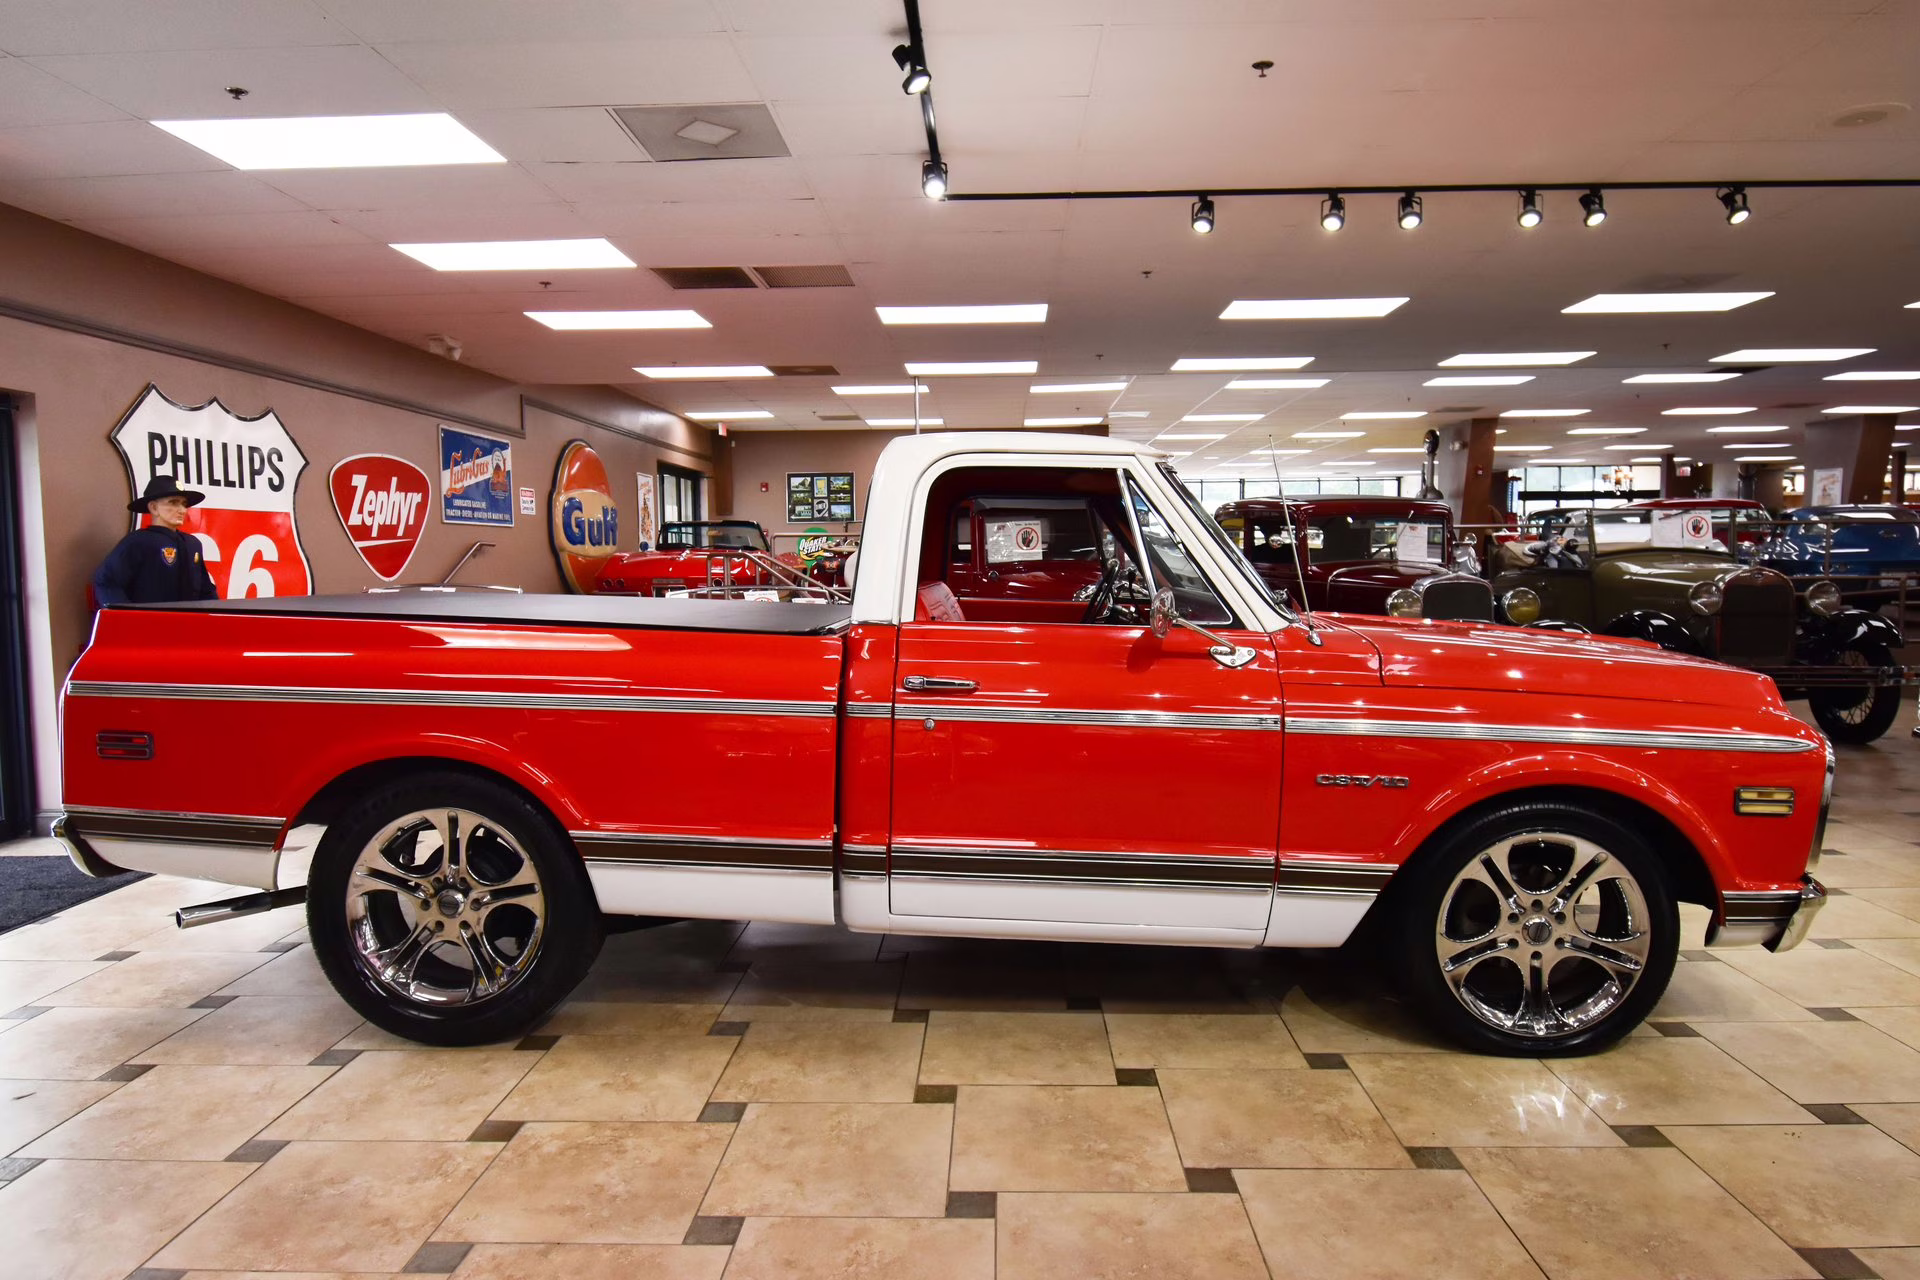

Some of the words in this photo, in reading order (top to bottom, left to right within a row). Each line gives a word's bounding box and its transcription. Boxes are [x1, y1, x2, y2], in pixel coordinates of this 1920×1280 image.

[148, 432, 284, 492] PHILLIPS
[347, 474, 422, 538] Zephyr
[562, 497, 618, 547] Gulf
[1316, 774, 1409, 788] CST/10
